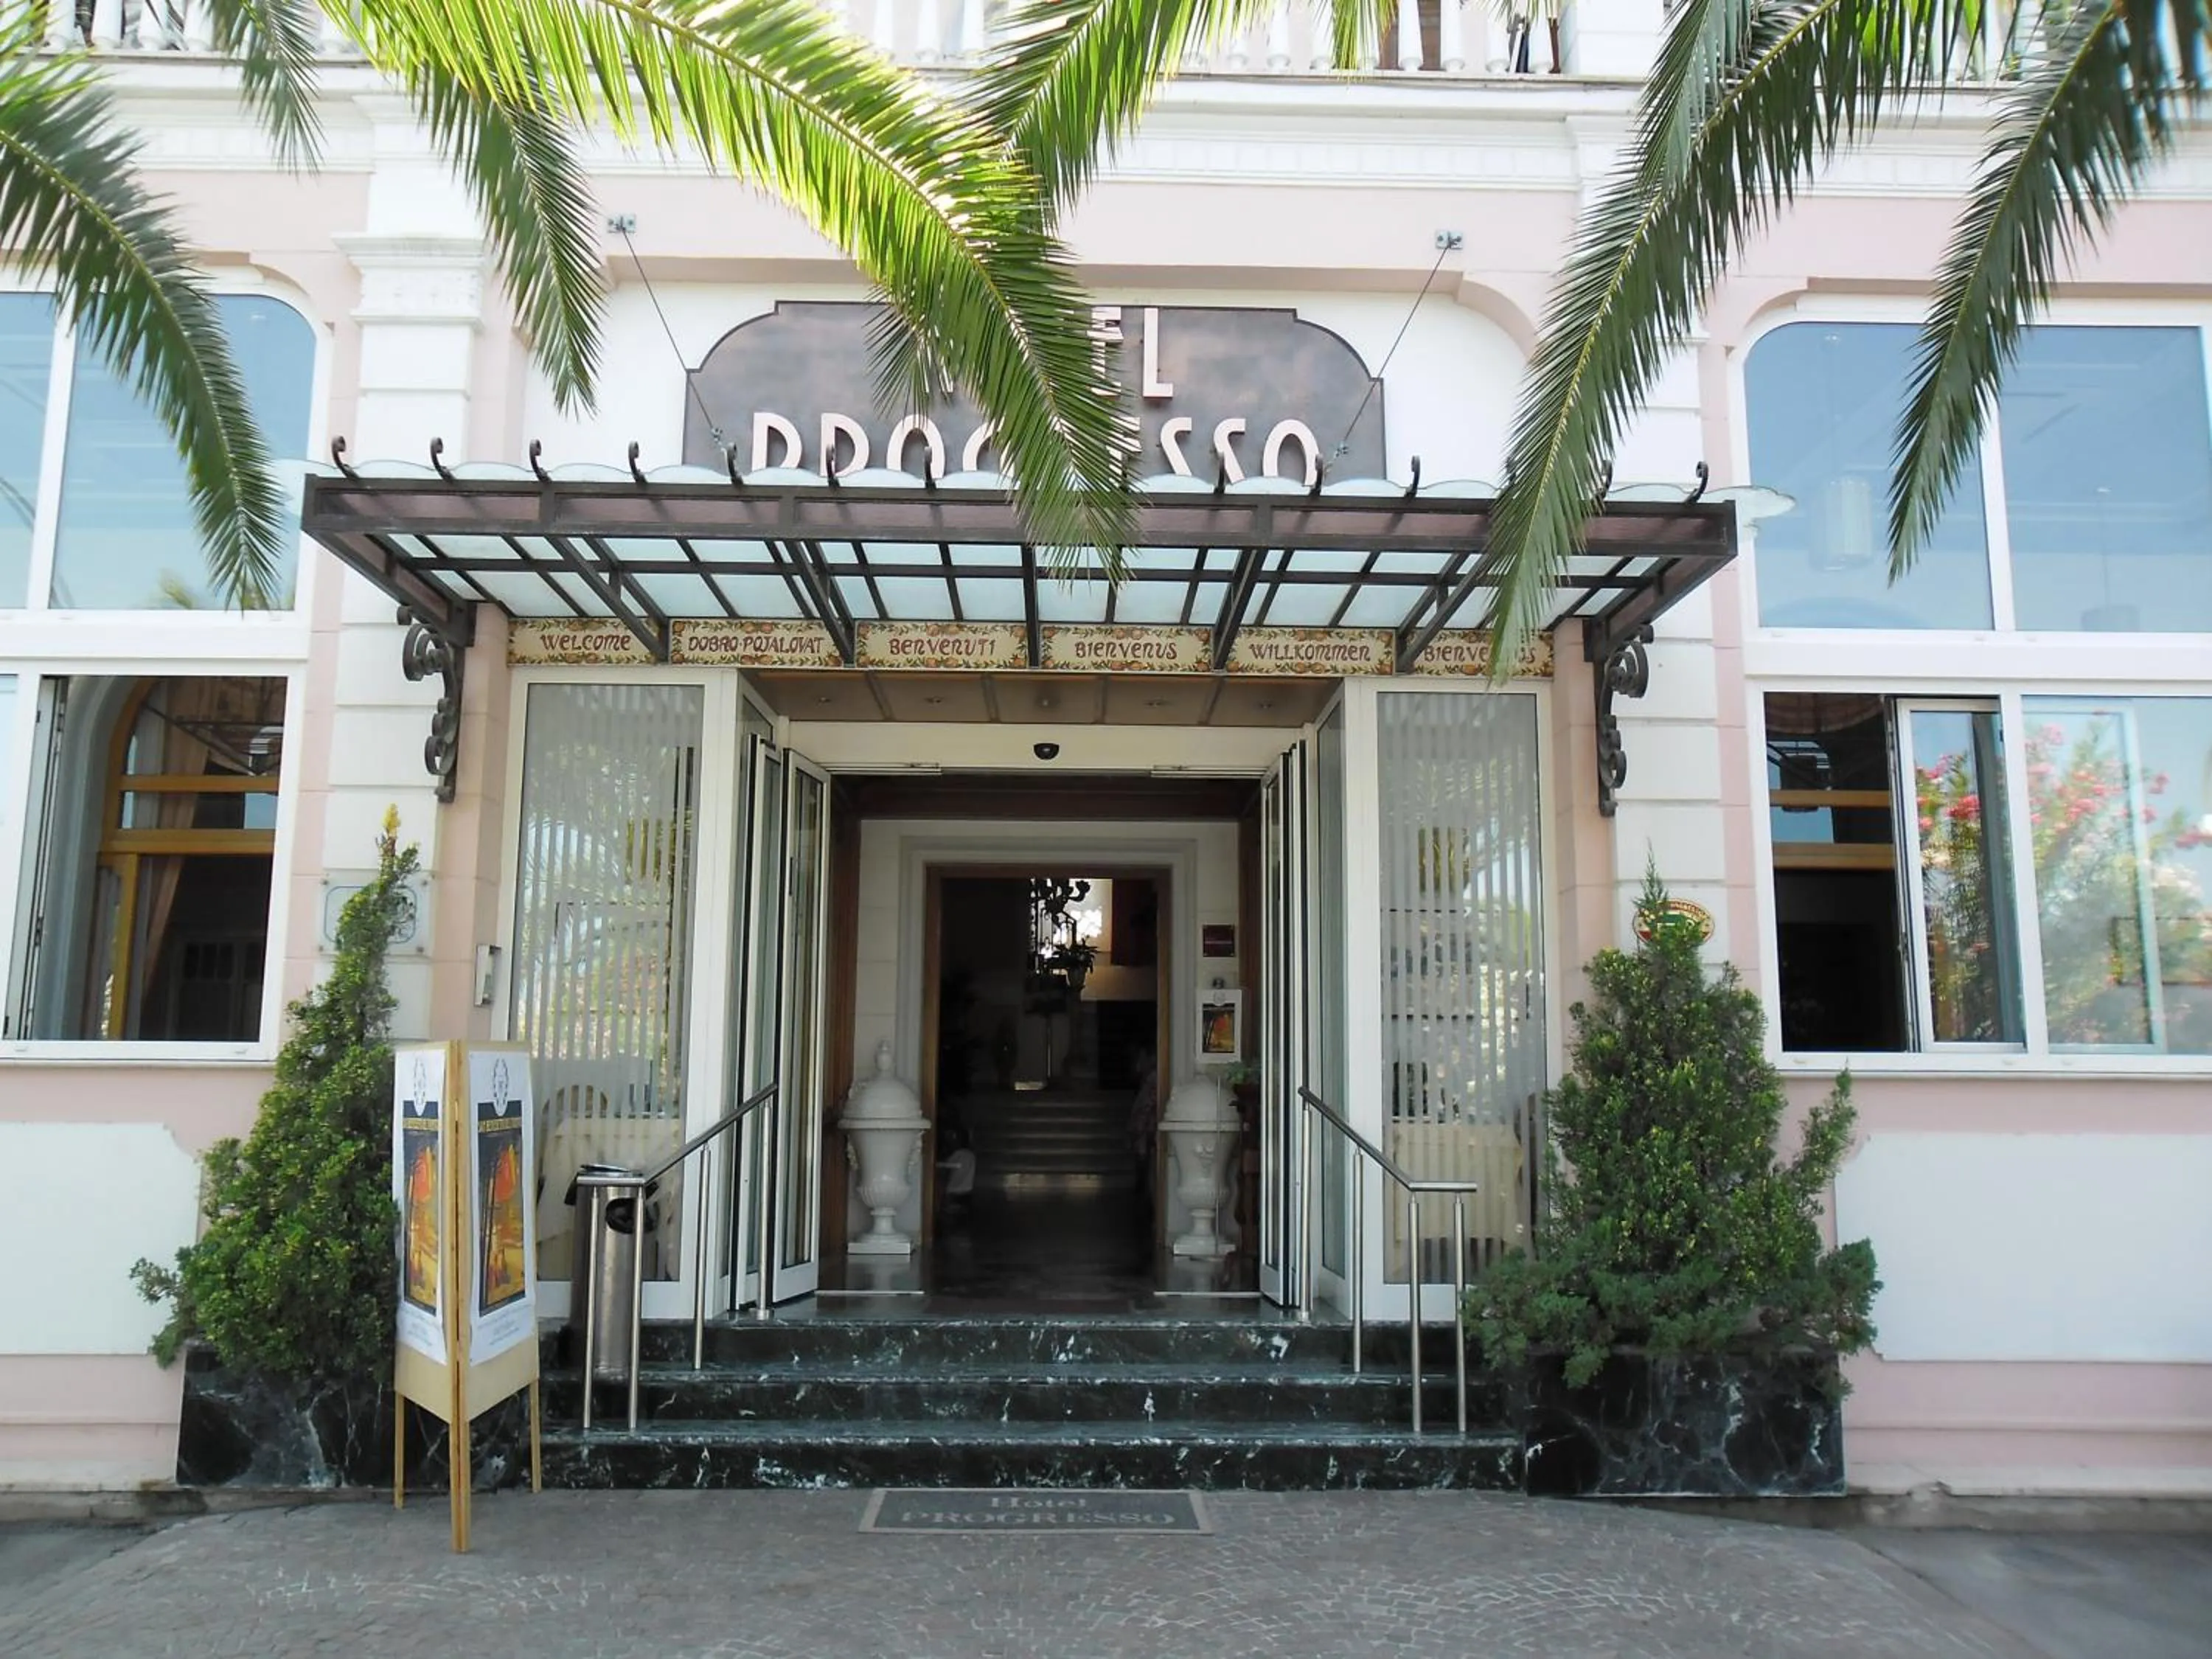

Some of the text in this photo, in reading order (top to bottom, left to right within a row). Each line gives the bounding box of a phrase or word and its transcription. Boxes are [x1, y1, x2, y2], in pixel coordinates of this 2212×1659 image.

[540, 634, 631, 651] WELCOME
[888, 637, 997, 655] BENVENUTI
[1074, 640, 1178, 661] BIENVENUS
[1249, 642, 1371, 662] WILLKOMMEN
[1424, 644, 1537, 664] BIENVES
[991, 1497, 1087, 1508] Hotel
[902, 1512, 1175, 1524] PROGRESSO
